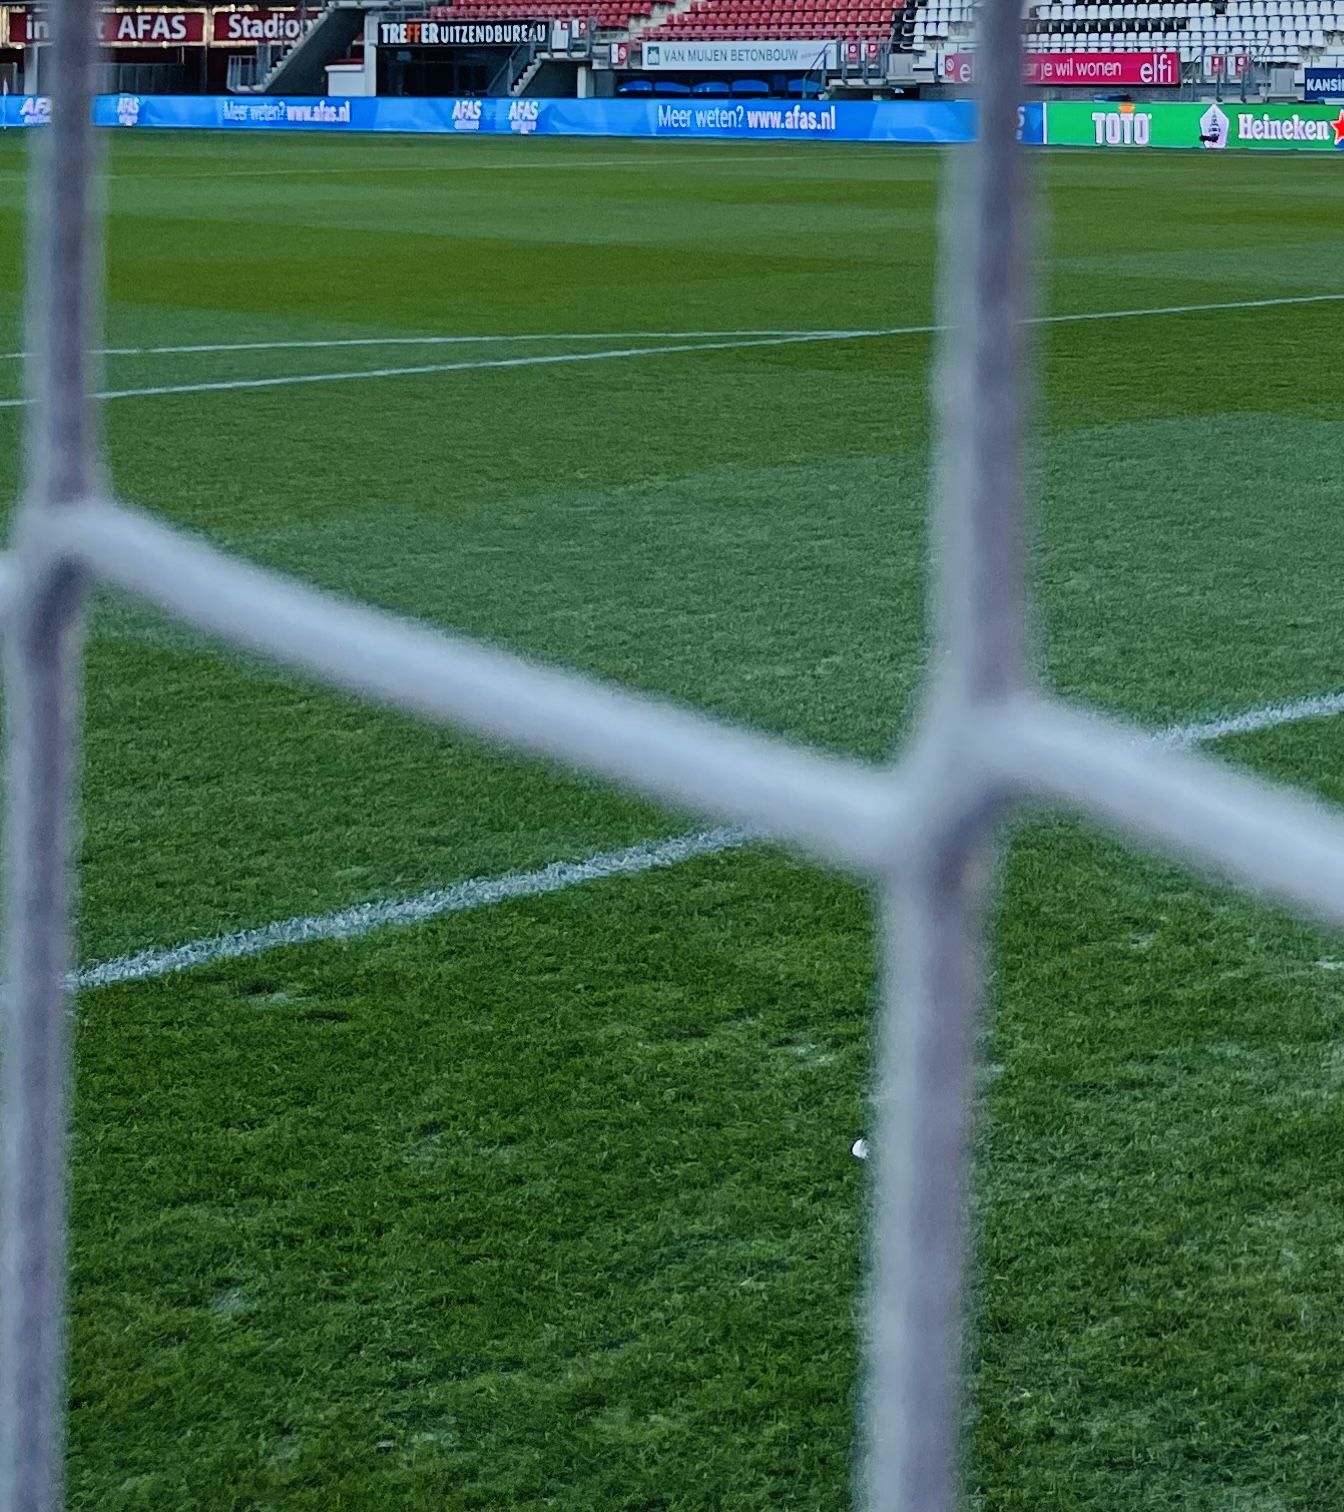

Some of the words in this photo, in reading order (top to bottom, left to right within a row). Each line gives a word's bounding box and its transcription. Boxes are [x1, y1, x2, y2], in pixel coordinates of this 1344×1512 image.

[117, 14, 187, 40] AFAS
[381, 23, 439, 44] TREFFER
[440, 24, 546, 44] UITZENDBUREAU
[663, 49, 685, 63] VAN
[687, 48, 728, 63] MUIJEN
[730, 47, 798, 62] BETONBOUW
[1040, 60, 1053, 80] je
[1055, 57, 1073, 76] wil
[1076, 61, 1122, 77] wonen
[1139, 54, 1173, 83] elfi
[286, 99, 350, 123] www.afas.nl
[452, 99, 482, 120] AFAS
[508, 99, 539, 121] AFAS
[657, 104, 692, 128] Meer
[695, 104, 744, 128] weten?
[747, 104, 836, 130] www.afas.nl
[1091, 112, 1150, 145] TOTO
[1237, 113, 1330, 140] Heineken
